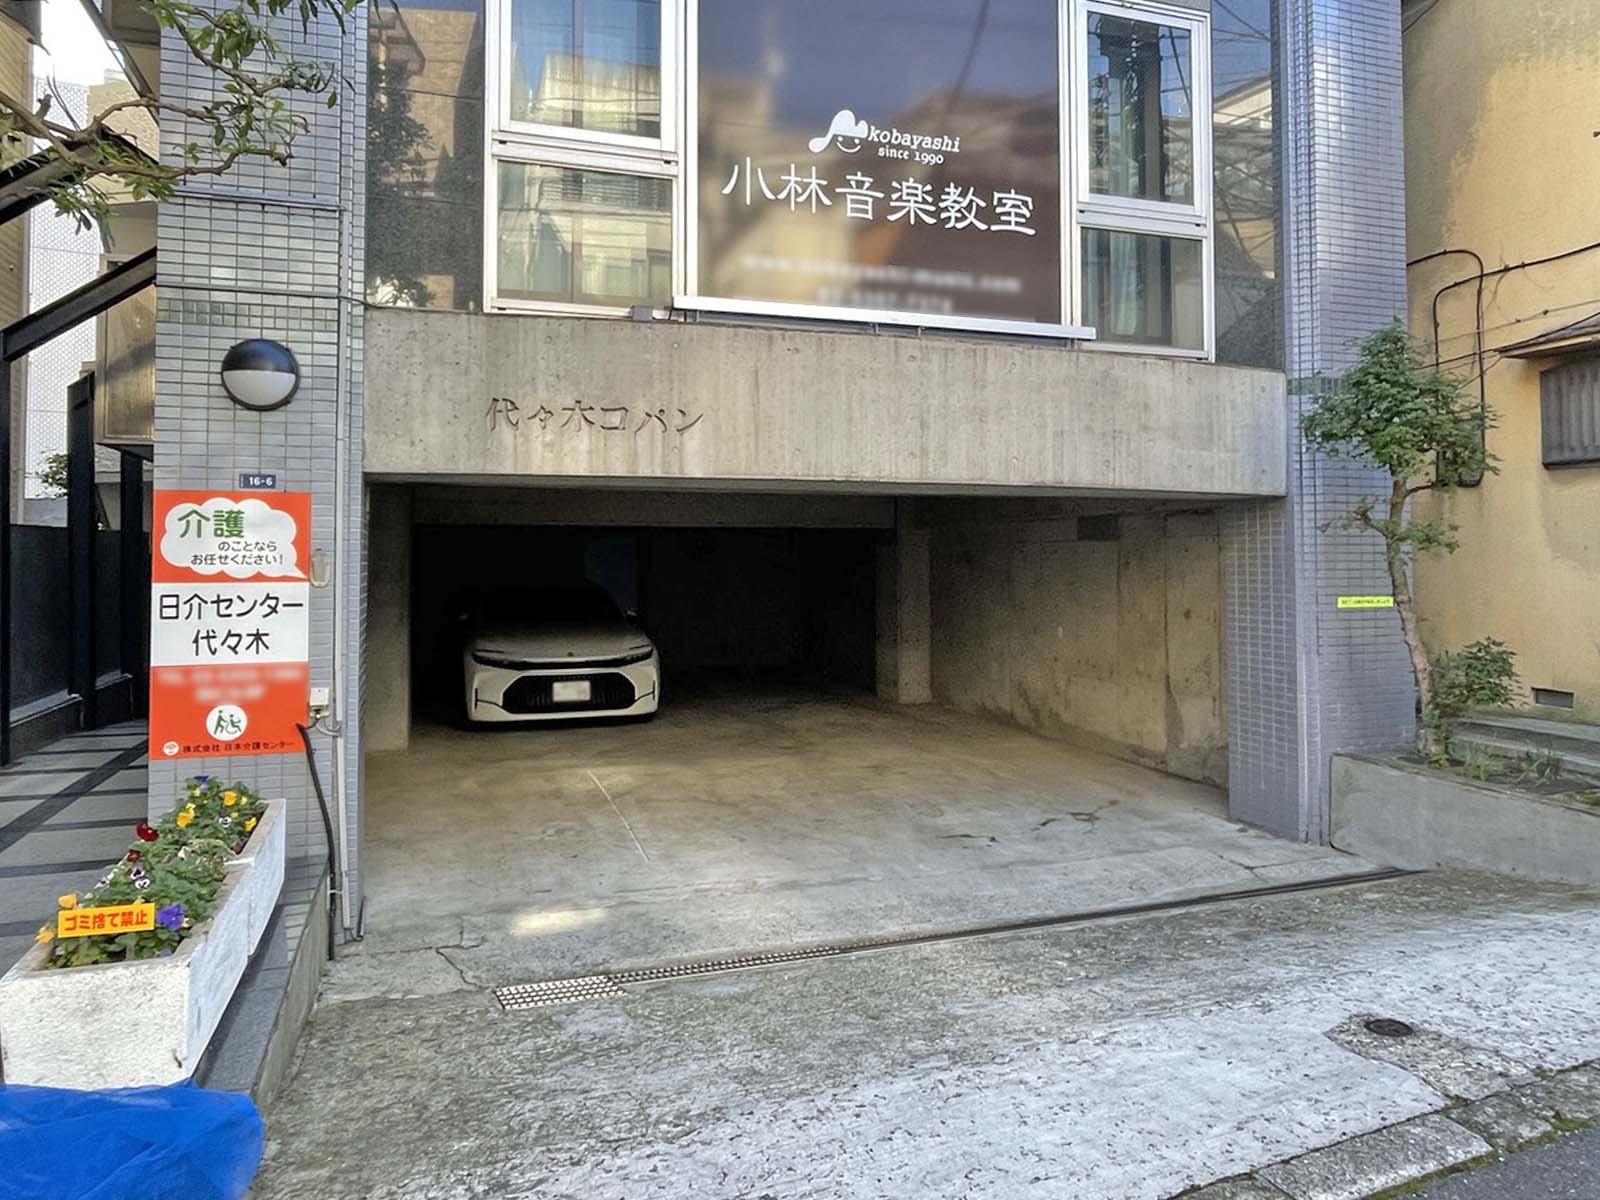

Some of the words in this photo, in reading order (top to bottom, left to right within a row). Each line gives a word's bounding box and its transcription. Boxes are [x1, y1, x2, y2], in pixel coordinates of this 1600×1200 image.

[868, 126, 961, 152] kobayashi
[878, 145, 909, 160] since
[914, 148, 944, 165] 1990
[721, 156, 1037, 235] 小林音楽教室
[485, 398, 703, 433] 代々木コパン
[249, 476, 273, 486] 16-6
[177, 509, 245, 538] 介護
[217, 541, 278, 552] のことなら
[159, 592, 304, 620] 日介センター
[192, 628, 270, 657] 代々木
[64, 910, 148, 931] ゴミ捨て禁止
